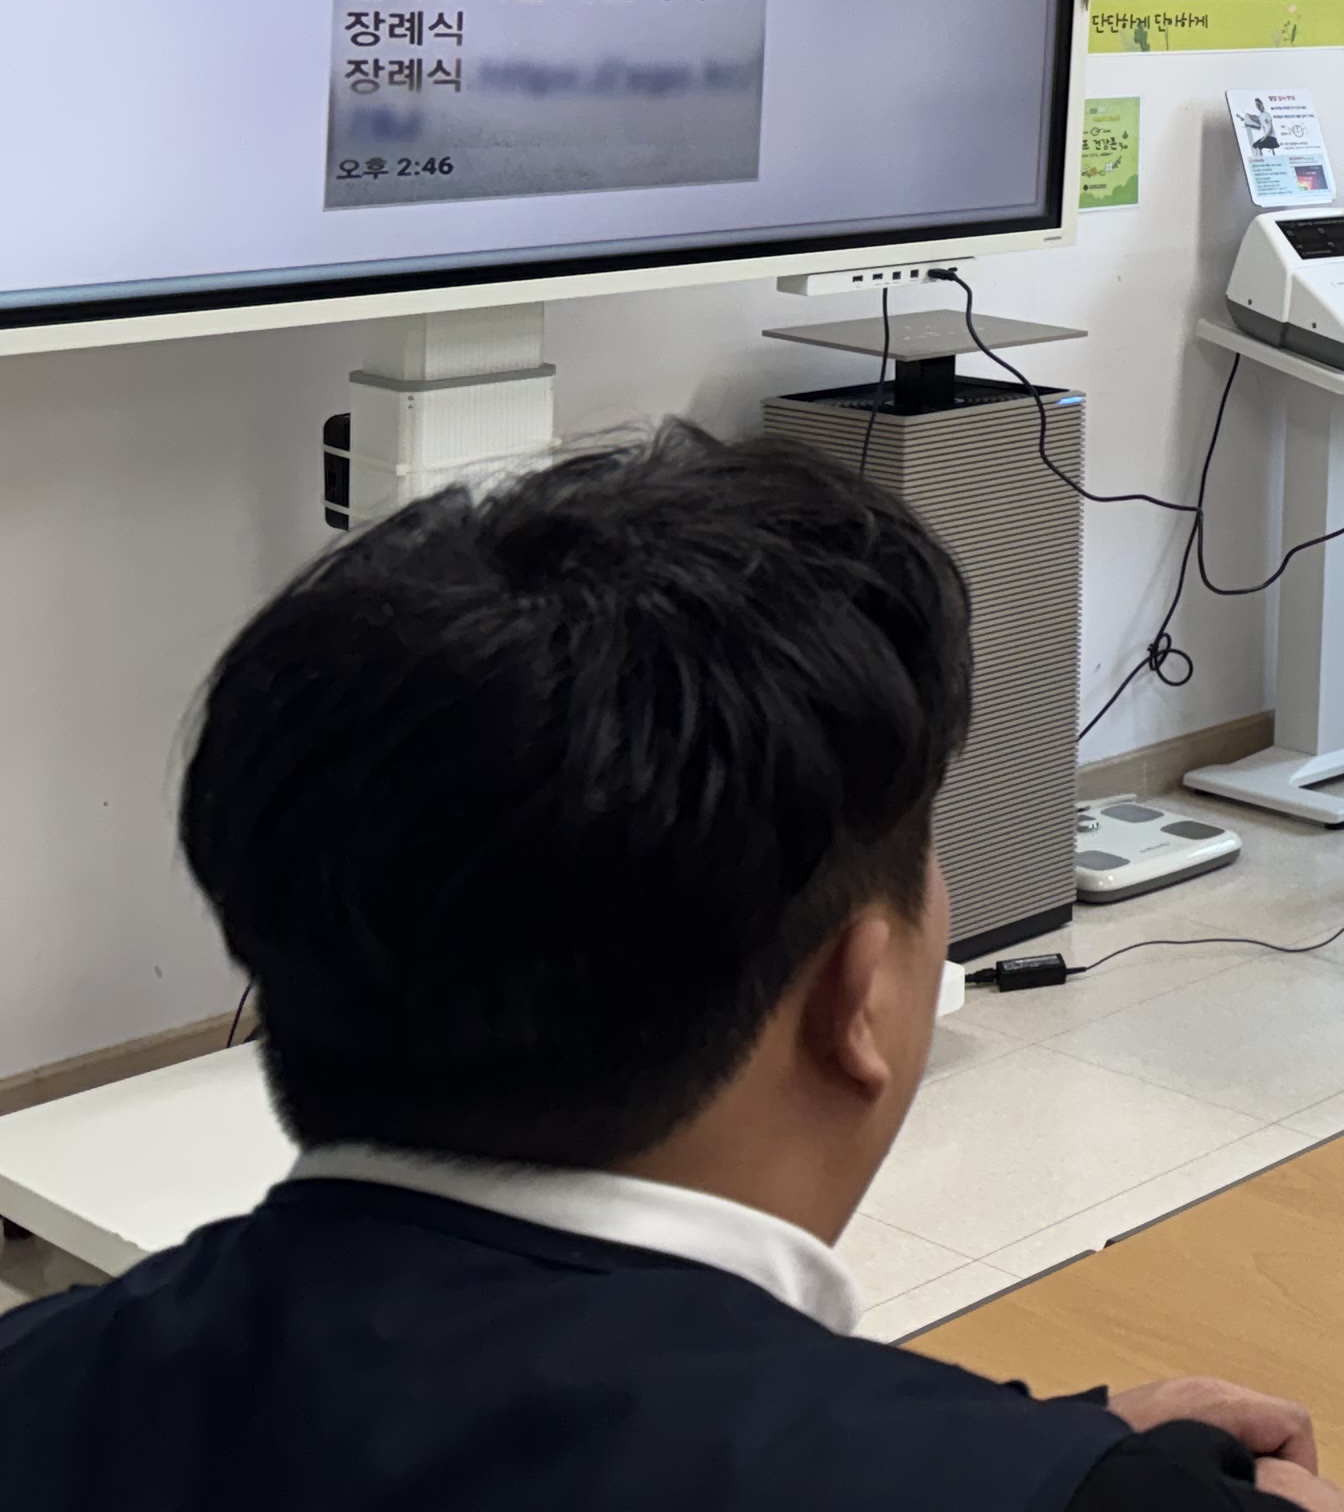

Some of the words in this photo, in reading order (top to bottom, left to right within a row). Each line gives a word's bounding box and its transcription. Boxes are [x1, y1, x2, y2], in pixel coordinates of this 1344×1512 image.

[344, 10, 464, 47] 장례식
[1092, 12, 1151, 33] 단단하게
[344, 58, 463, 94] 장례식
[336, 158, 389, 180] 오후
[396, 156, 454, 176] 2:46
